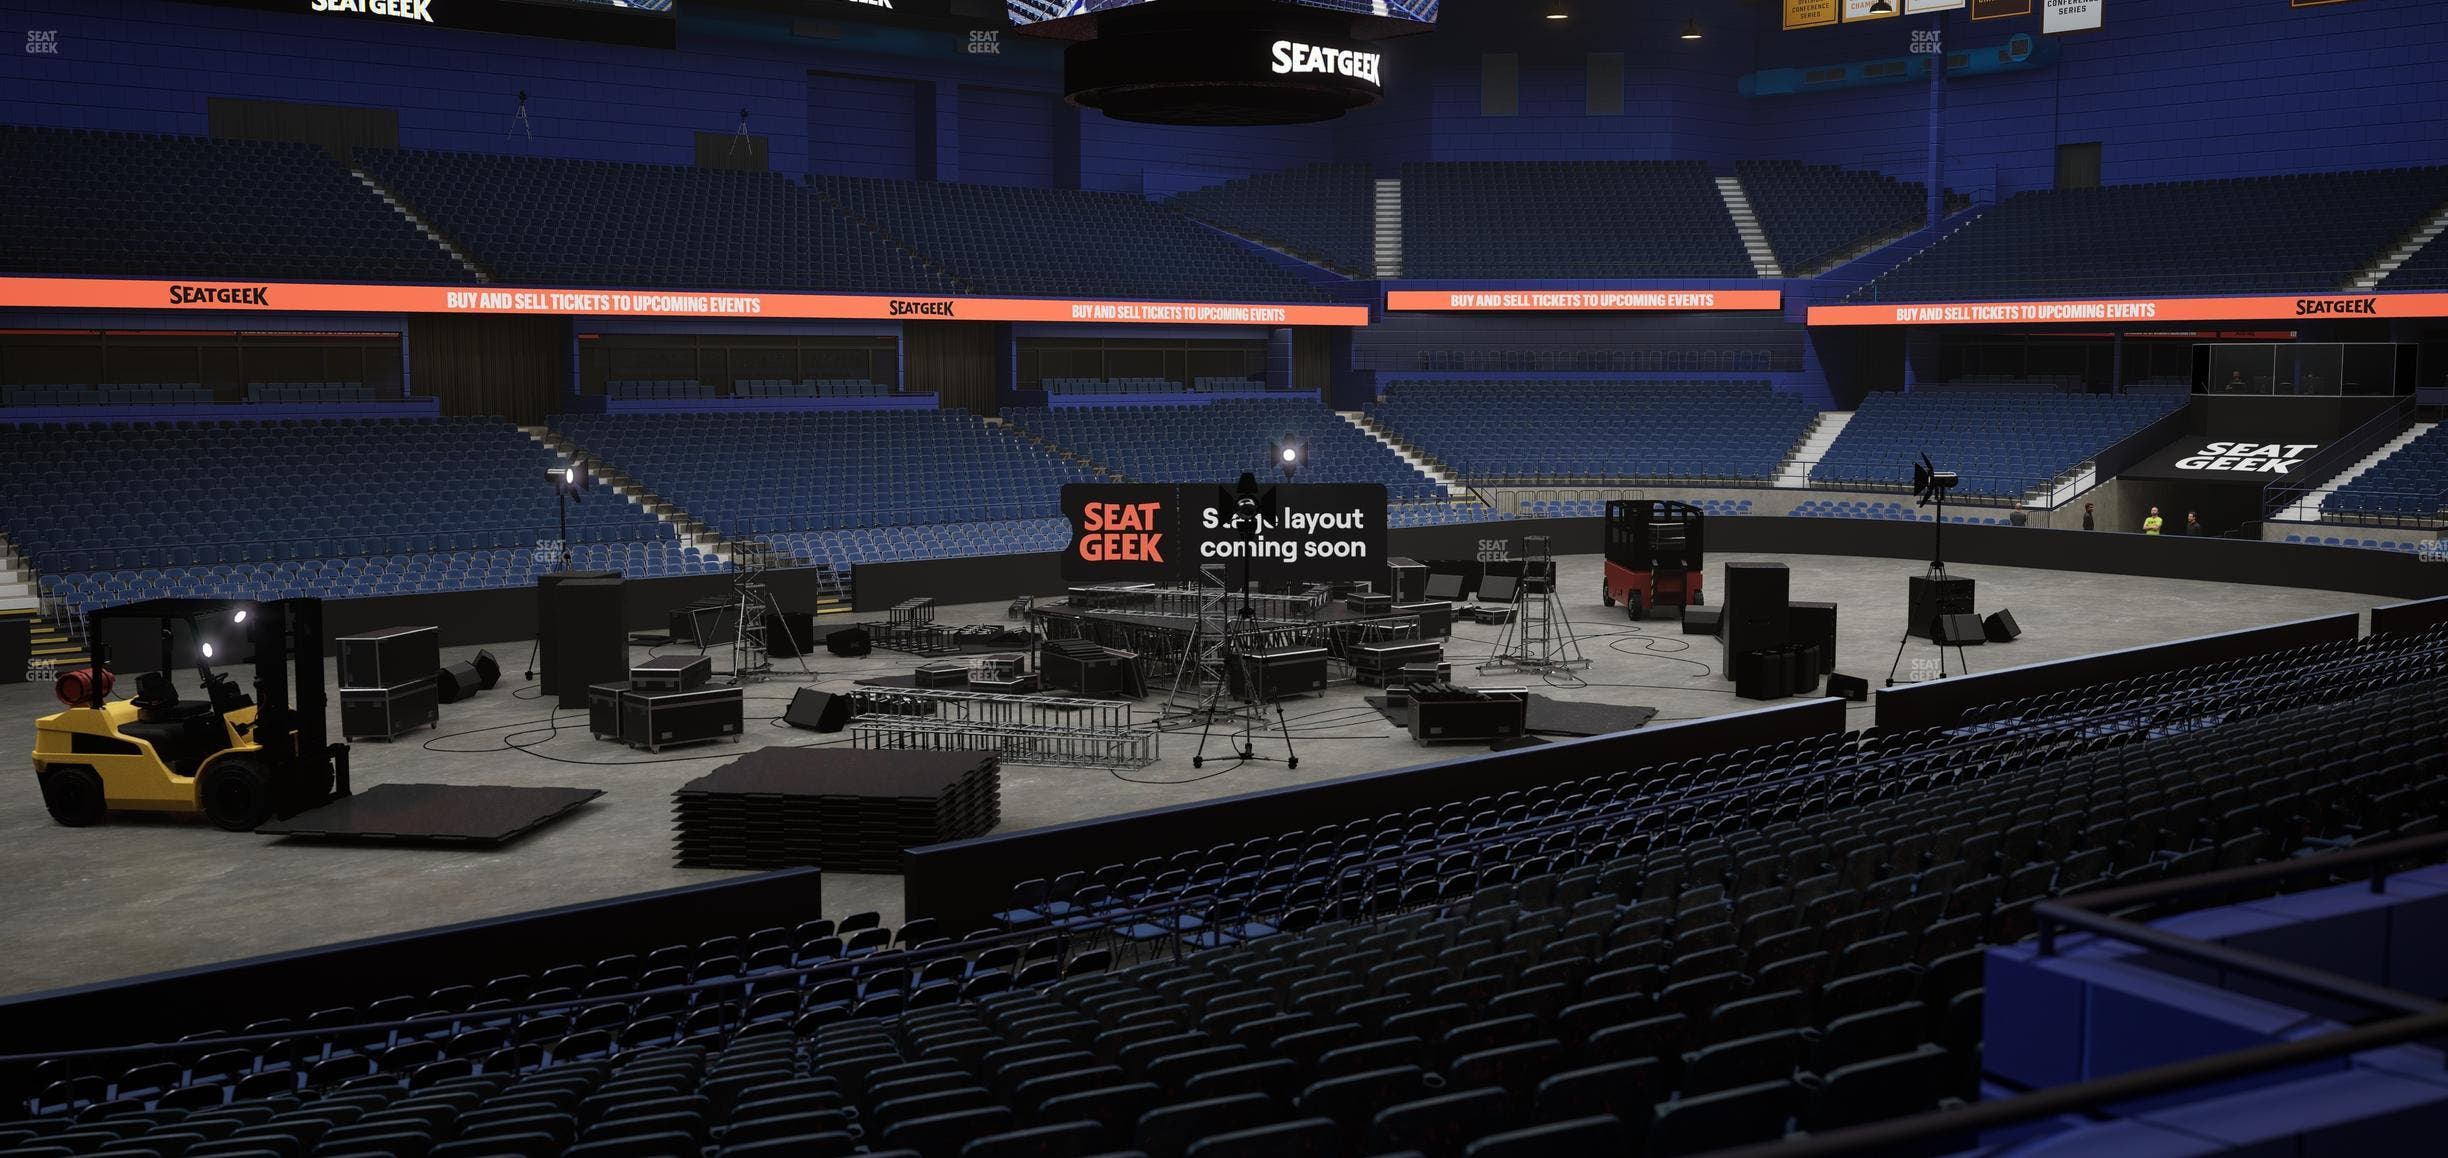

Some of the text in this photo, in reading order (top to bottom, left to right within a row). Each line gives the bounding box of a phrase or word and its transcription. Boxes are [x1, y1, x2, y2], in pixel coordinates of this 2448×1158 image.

[2058, 5, 2086, 15] SERIES
[1272, 40, 1380, 87] SEATGEEK
[169, 285, 269, 306] SEATGEEK
[447, 291, 761, 314] BUY AND SELL TICKETS TO UPCOMING EVENTS
[1451, 294, 1714, 307] BUY AND SELL TICKETS TO UPCOMING EVENTS
[889, 300, 954, 317] SEATGEEK
[1072, 304, 1285, 322] BUY AND SELL TICKETS TO UPCOMING EVENTS
[1896, 303, 2155, 321] BUY AND SELL TICKETS TO UPCOMING EVENTS
[2296, 298, 2376, 315] SEATGEEK
[2197, 442, 2318, 458] SEAT
[2174, 456, 2304, 474] GEEK
[1083, 502, 1161, 531] SEAT
[1284, 507, 1364, 535] layout
[1079, 533, 1164, 563] GEEK
[1200, 535, 1367, 563] coming soon
